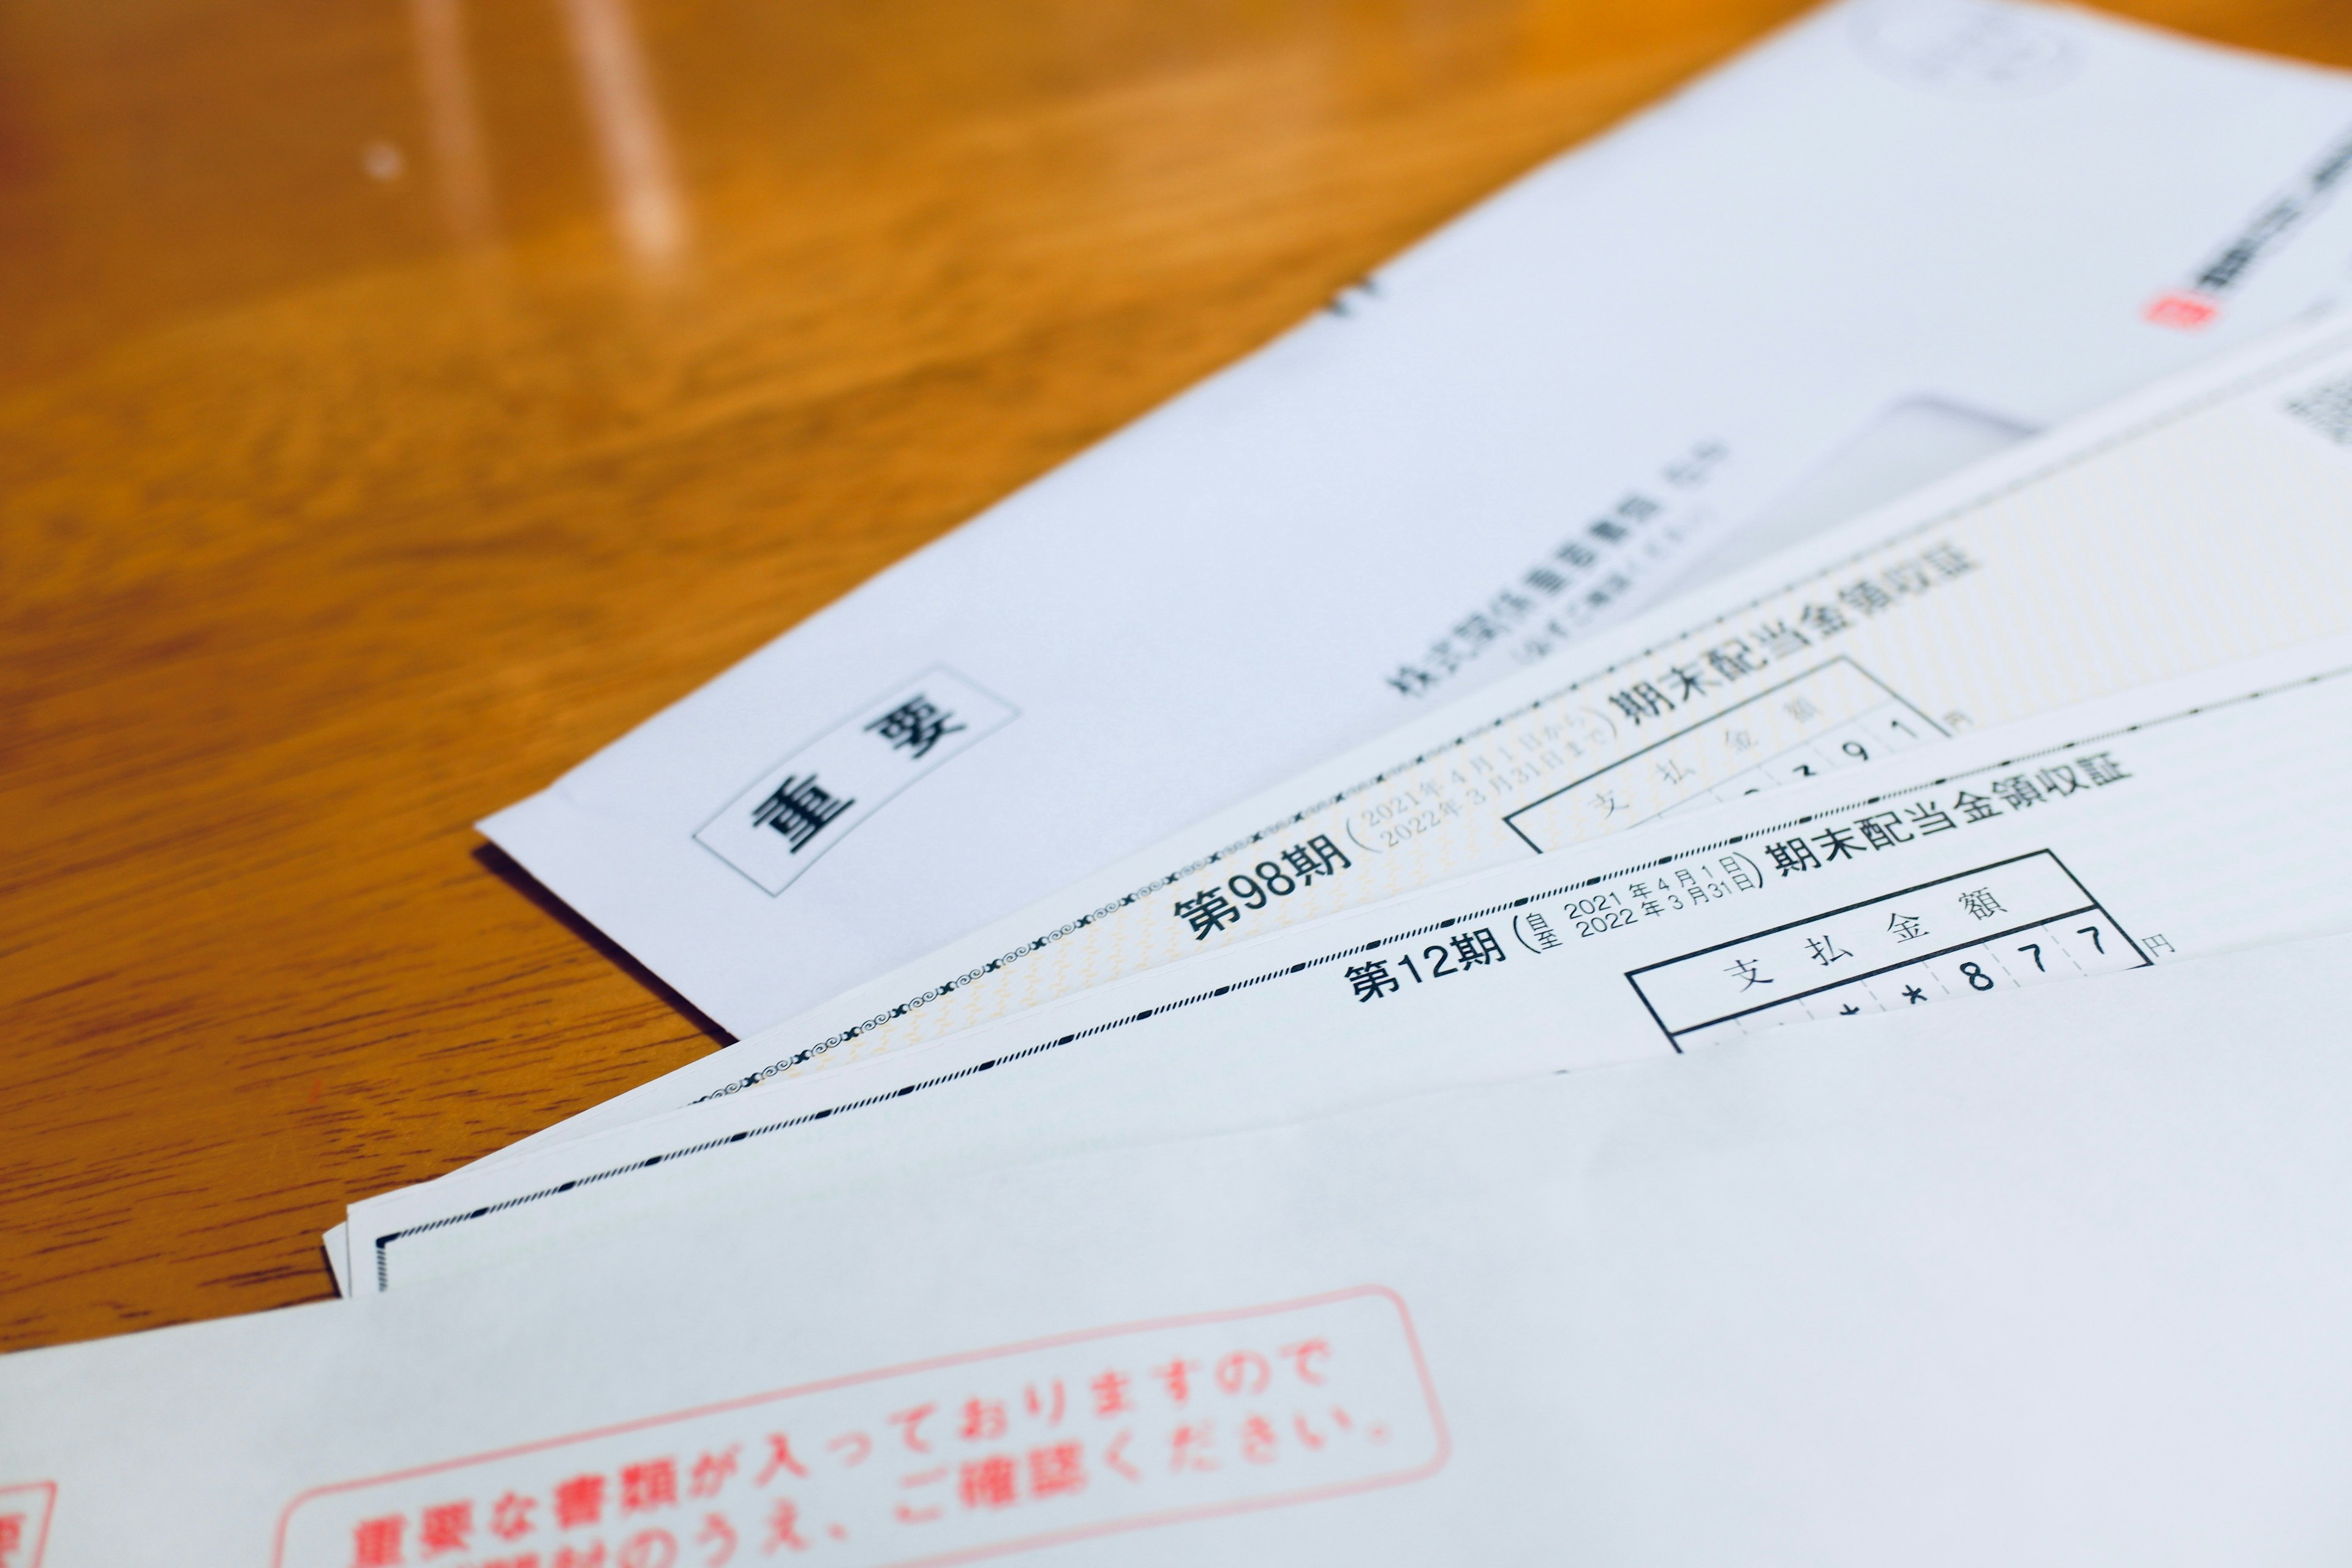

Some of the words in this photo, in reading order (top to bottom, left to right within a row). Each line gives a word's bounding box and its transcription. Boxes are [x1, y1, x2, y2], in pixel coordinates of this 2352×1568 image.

[752, 774, 967, 854] 重要
[1174, 834, 1351, 941] 第98期
[1608, 541, 1980, 726] 期末配当金領収証
[1344, 928, 1506, 1003] 第12期
[1765, 751, 2132, 876] 期末配当金領収証
[1723, 887, 2008, 992] 支払金額
[2141, 933, 2174, 957] 円
[353, 1338, 1330, 1568] 重要な書類が入っておりますので
[461, 1406, 1392, 1568] 封のうえ、ご確認ください。
